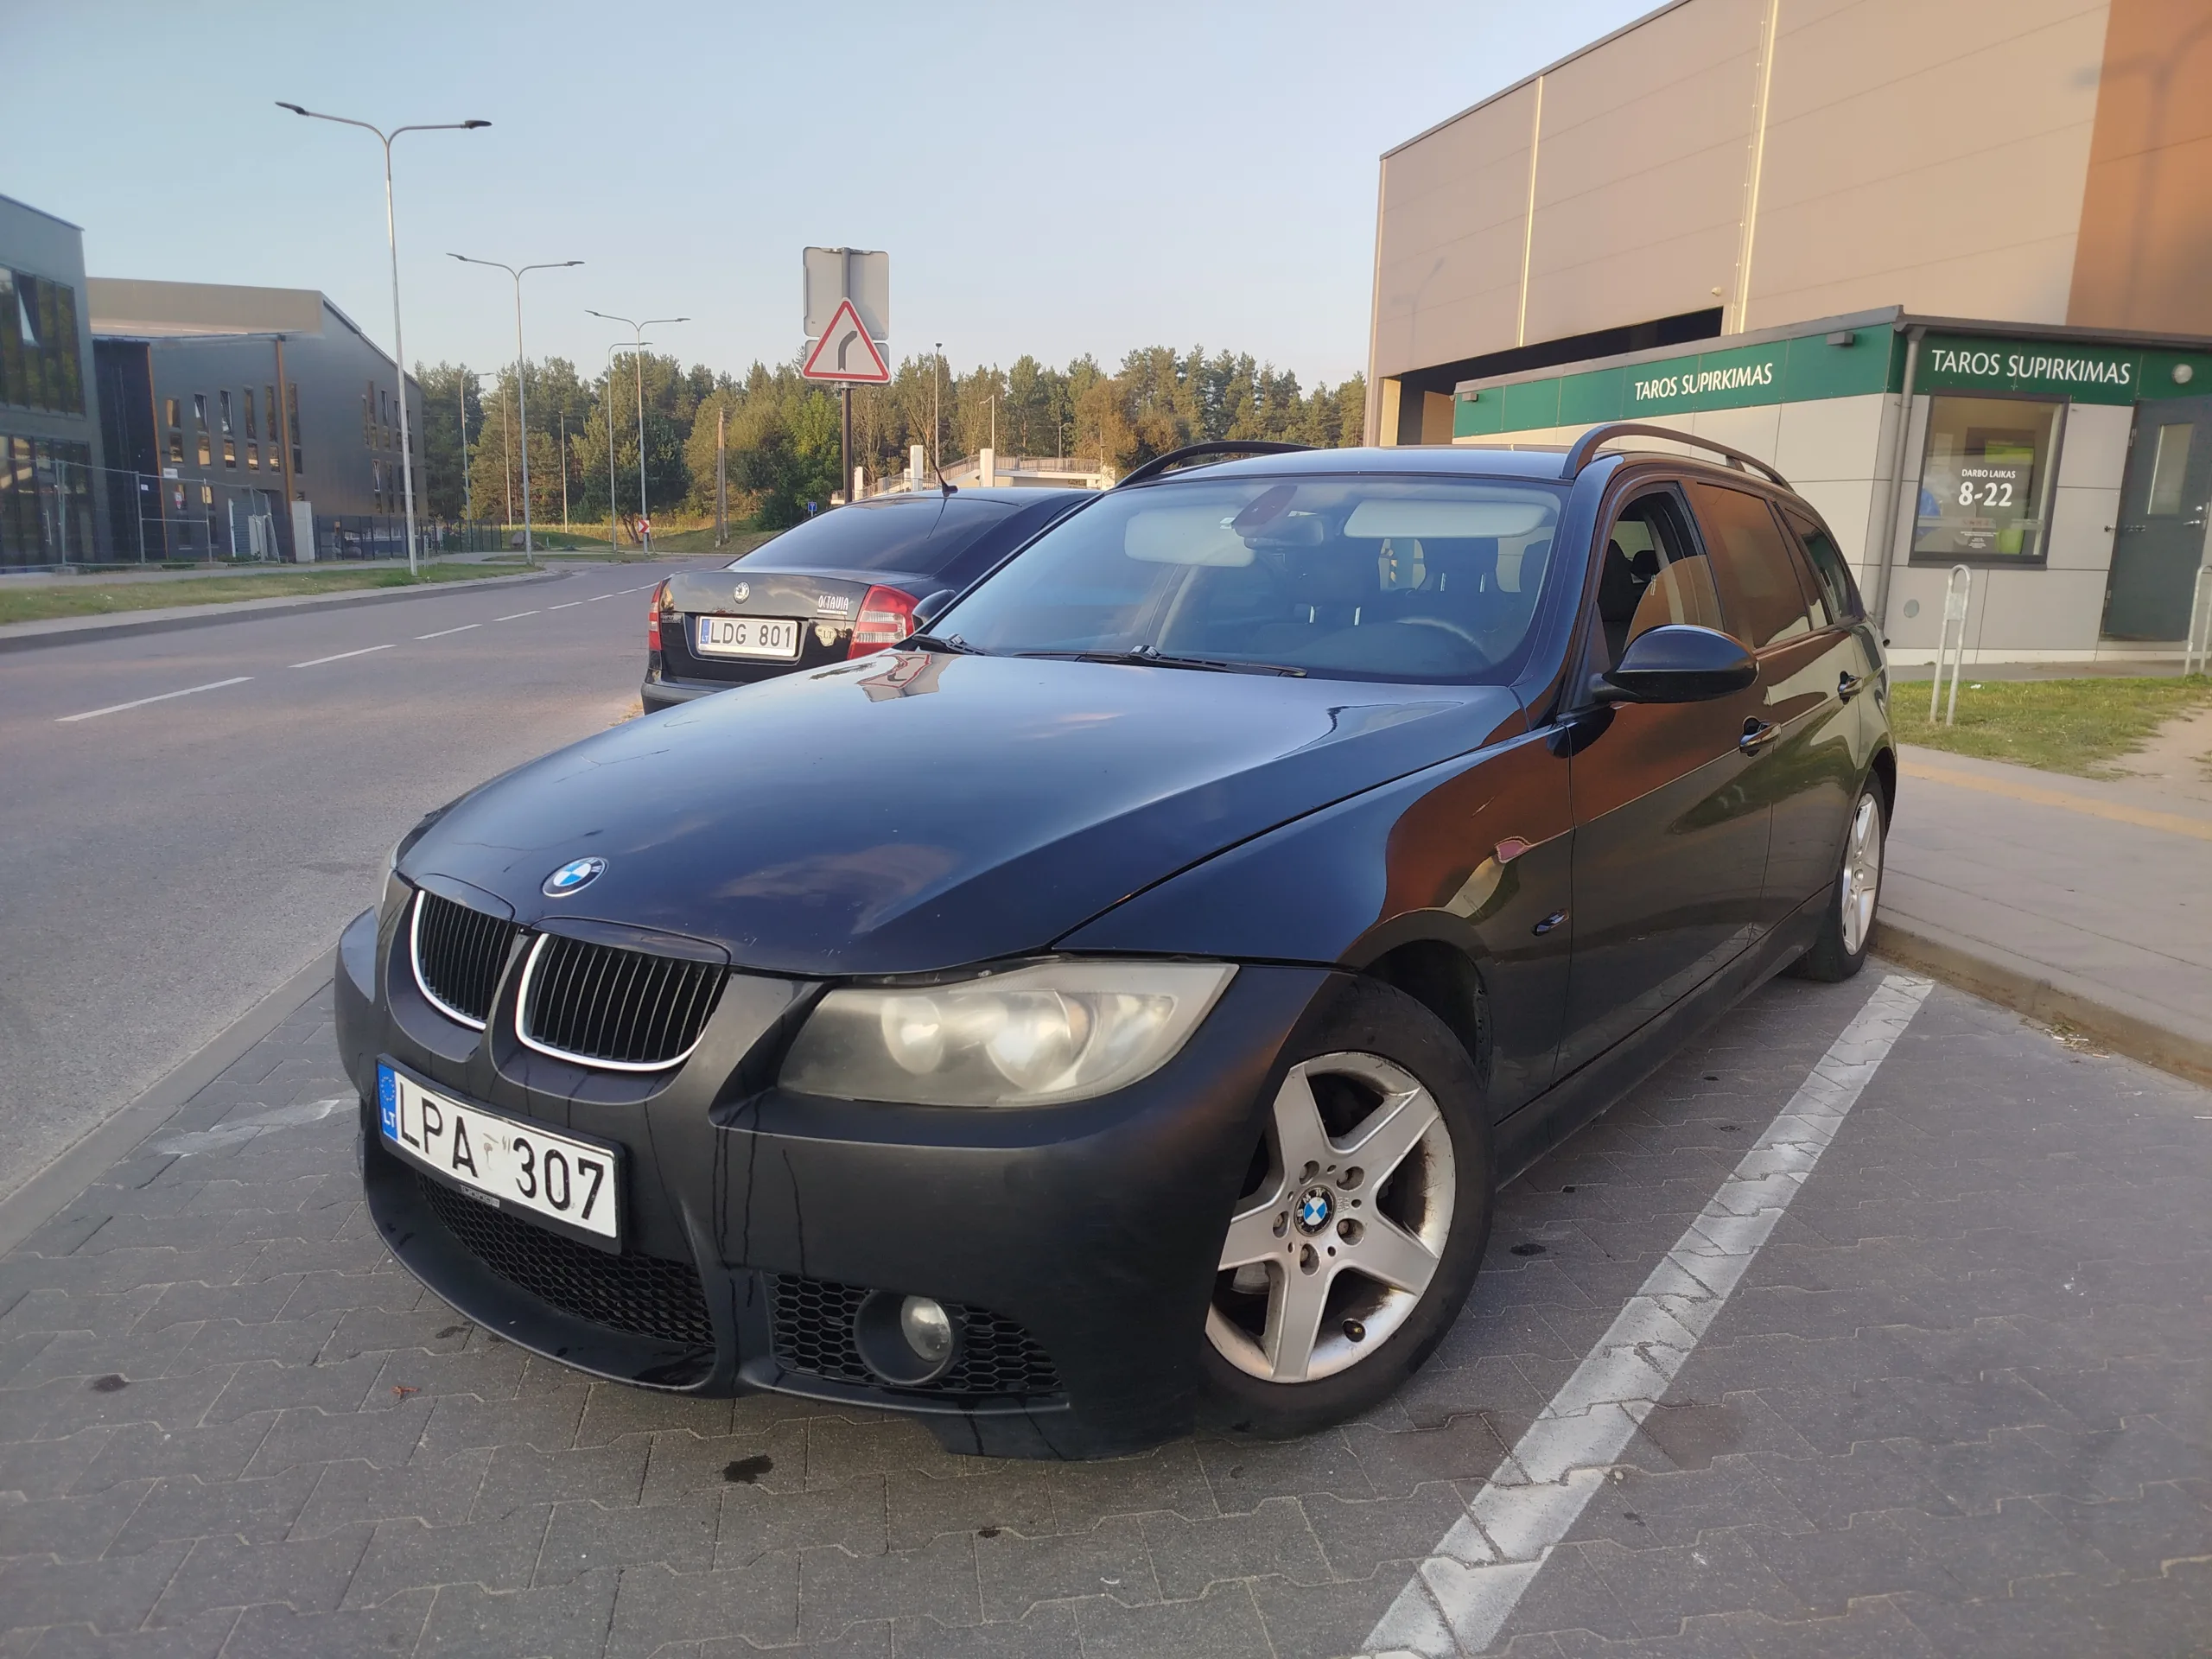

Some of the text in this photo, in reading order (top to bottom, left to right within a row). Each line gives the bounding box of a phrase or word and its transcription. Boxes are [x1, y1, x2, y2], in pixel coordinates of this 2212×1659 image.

[1634, 362, 1773, 401] TAROS SUPIRKIMAS
[1931, 349, 2132, 385] TAROS SUPIRKIMAS
[1961, 468, 2016, 479] DARBO LAIKAS
[1958, 481, 2012, 507] 8-22
[710, 622, 747, 645] LDG
[759, 624, 791, 648] 801
[383, 1081, 604, 1221] LT LPA 307
[1296, 1187, 1325, 1218] BMW
